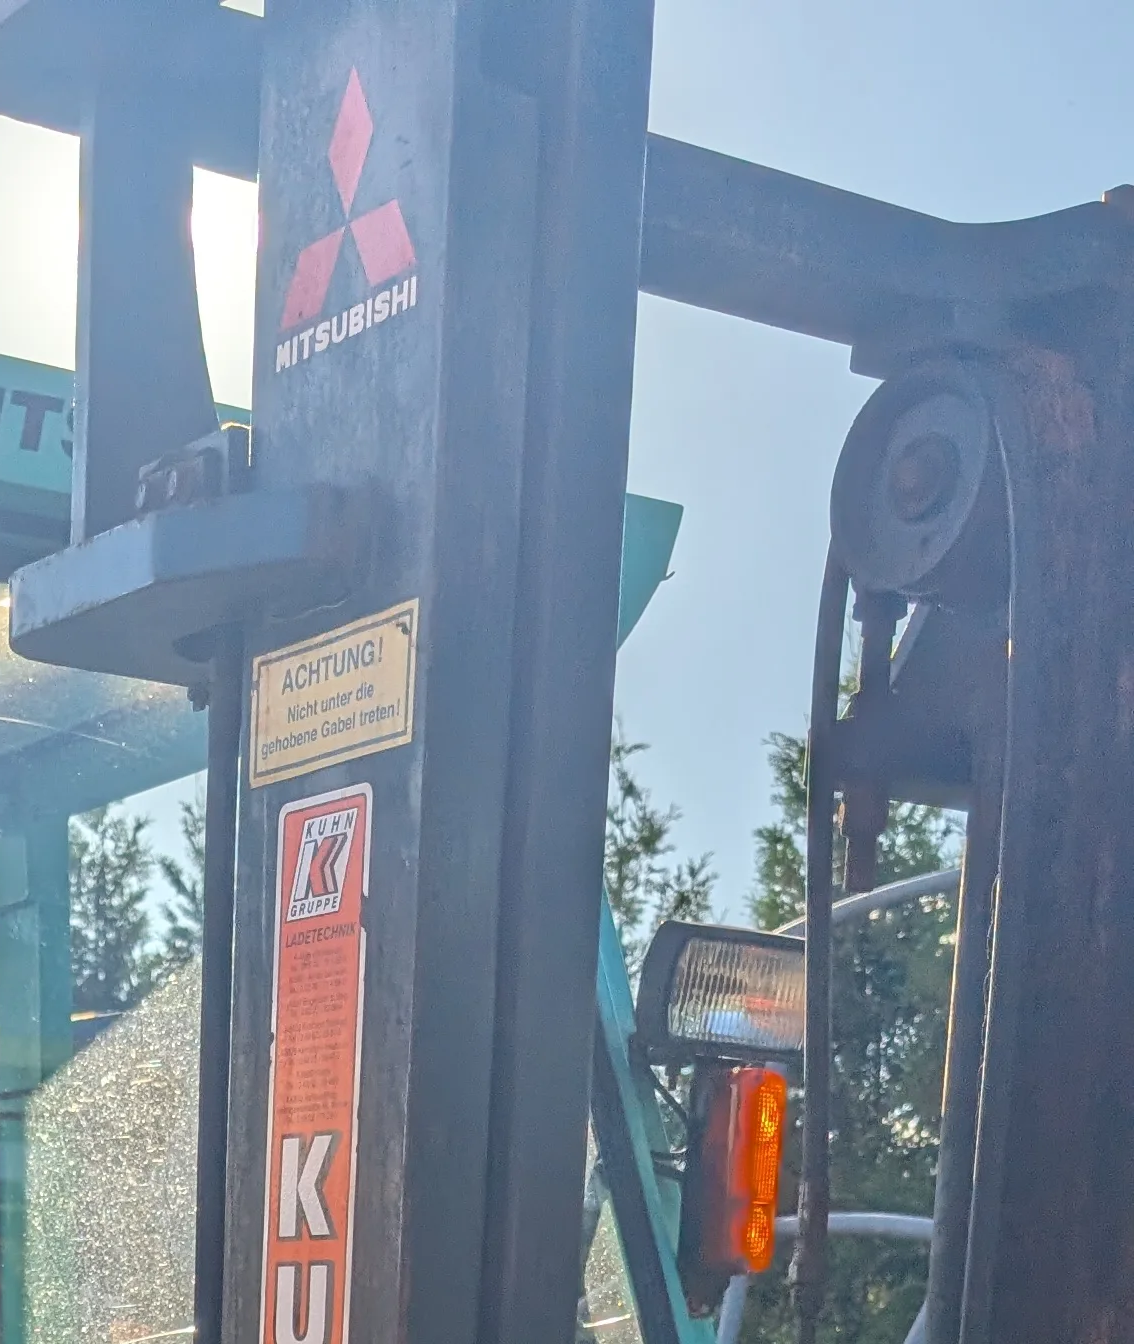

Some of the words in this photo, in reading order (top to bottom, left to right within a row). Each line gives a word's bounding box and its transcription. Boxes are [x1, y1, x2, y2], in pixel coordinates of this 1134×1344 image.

[276, 275, 417, 373] MITSUBISHI
[281, 636, 384, 696] ACHTUNG!
[287, 699, 318, 724] Nicht
[320, 690, 353, 713] unter
[356, 681, 375, 701] die
[261, 727, 318, 761] gehobene
[321, 711, 356, 738] Gabel
[305, 811, 355, 840] KUHN
[290, 895, 339, 918] GRUPPE
[285, 921, 357, 949] LADETECHNIK
